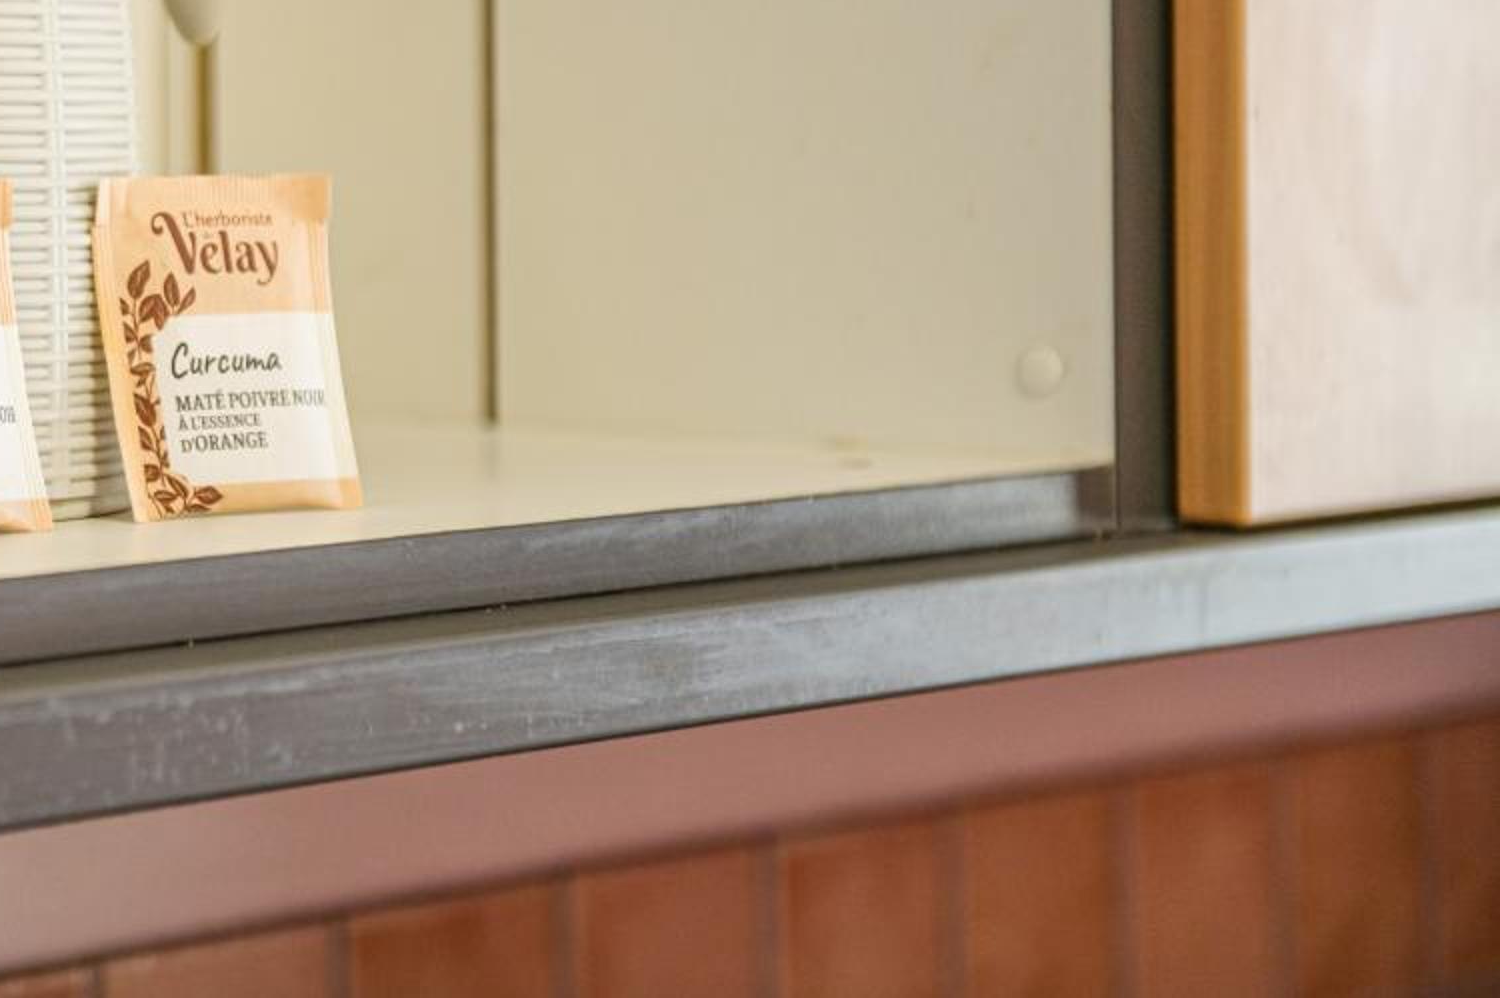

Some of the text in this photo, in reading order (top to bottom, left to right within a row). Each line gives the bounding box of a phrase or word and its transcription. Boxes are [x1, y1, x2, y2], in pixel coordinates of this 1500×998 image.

[151, 211, 278, 286] Velay
[171, 342, 282, 379] Curcuma
[174, 389, 224, 412] MATÉ
[227, 388, 291, 409] POIVRE
[178, 412, 261, 431] À L'ESSENCE
[180, 431, 269, 453] D'ORANGE
